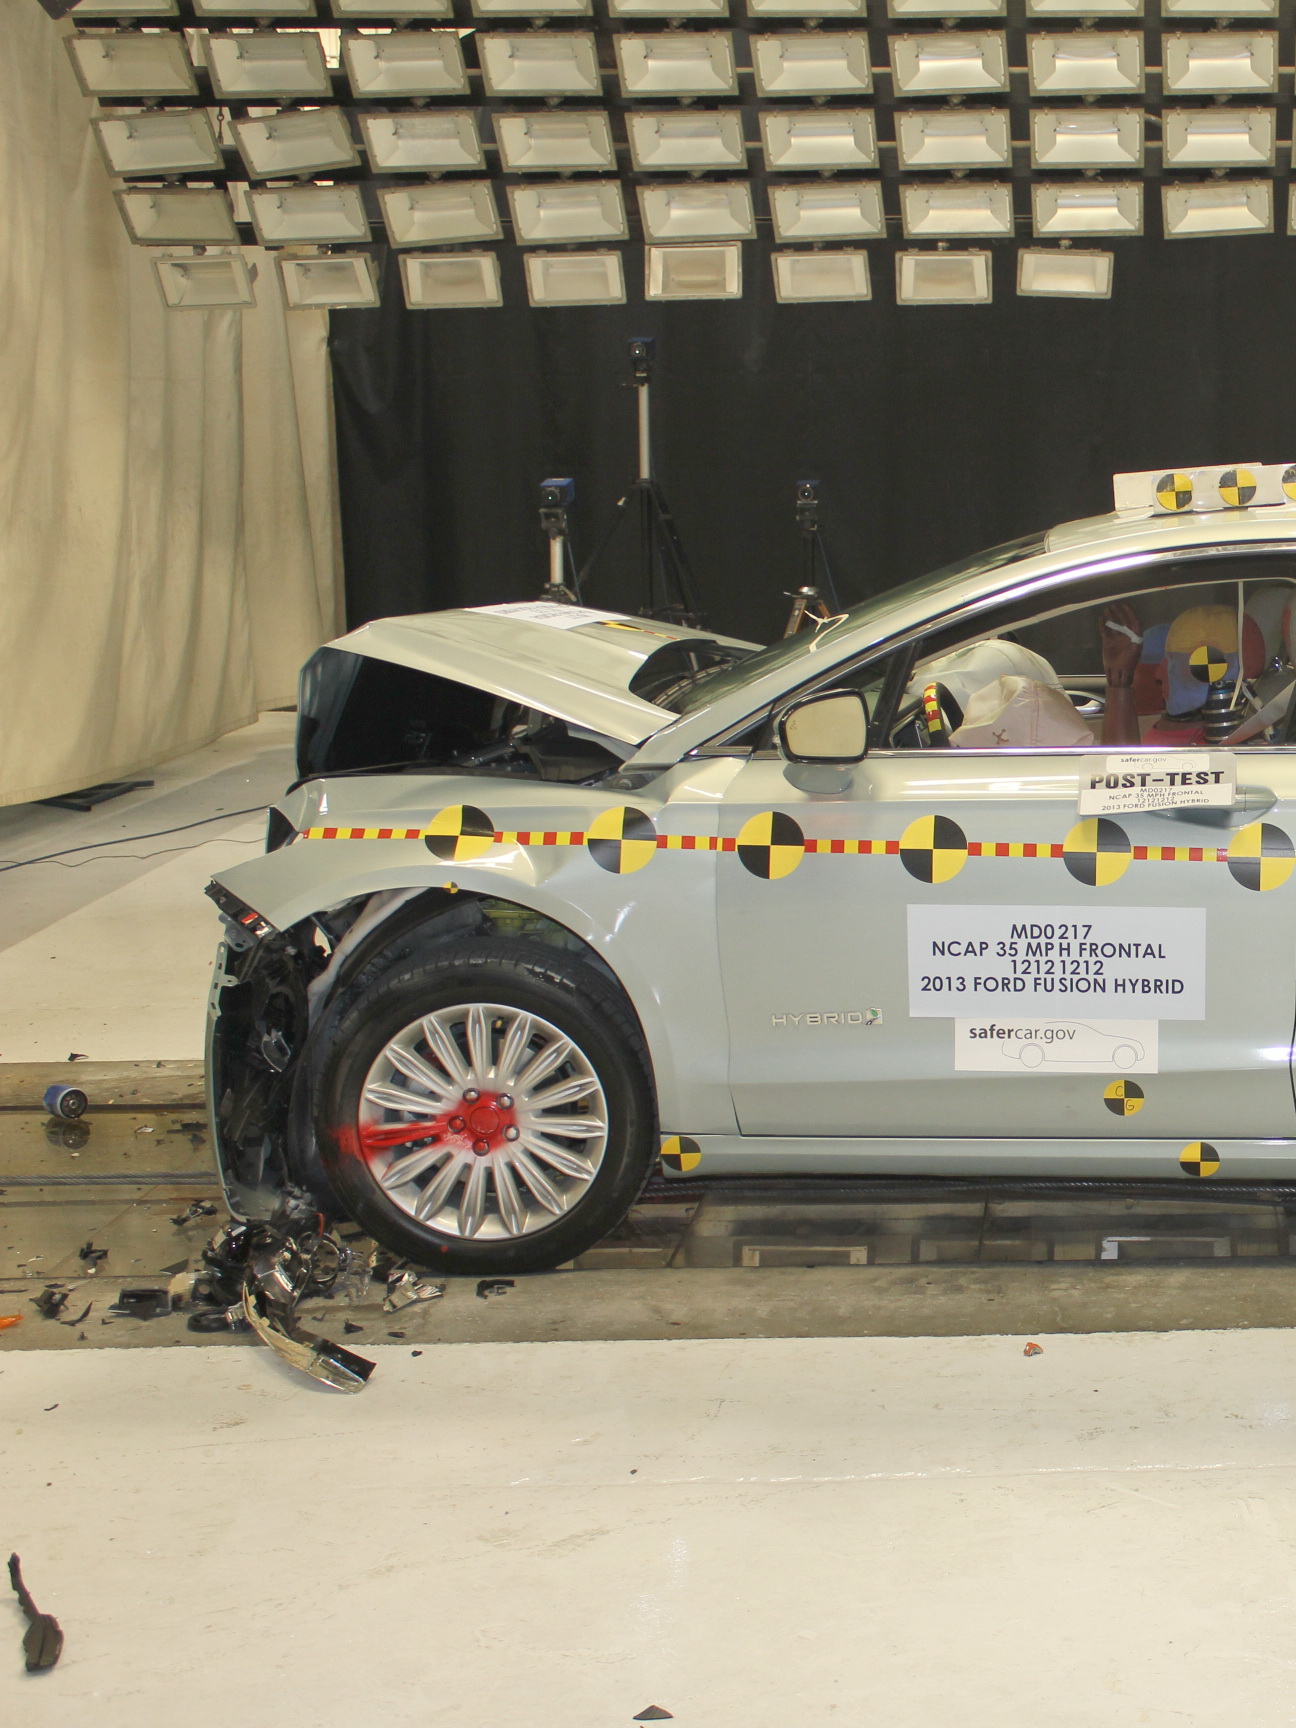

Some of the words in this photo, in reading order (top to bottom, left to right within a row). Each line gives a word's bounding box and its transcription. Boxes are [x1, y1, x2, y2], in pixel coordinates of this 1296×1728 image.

[1090, 771, 1224, 789] POST-TEST
[1108, 793, 1133, 801] NCAP
[1122, 802, 1146, 810] FORD
[1010, 924, 1093, 940] MD0217
[932, 941, 989, 957] NCAP
[996, 942, 1018, 957] 35
[1025, 942, 1071, 958] MPH
[1078, 943, 1166, 959] FRONTAL
[1010, 960, 1104, 976] 12121212
[920, 976, 967, 992] 2013
[974, 977, 1026, 993] FORD
[1033, 977, 1107, 994] FUSION
[1114, 978, 1185, 995] HYBRID
[771, 1012, 863, 1026] HYBRID
[969, 1024, 1077, 1043] safercar.gov
